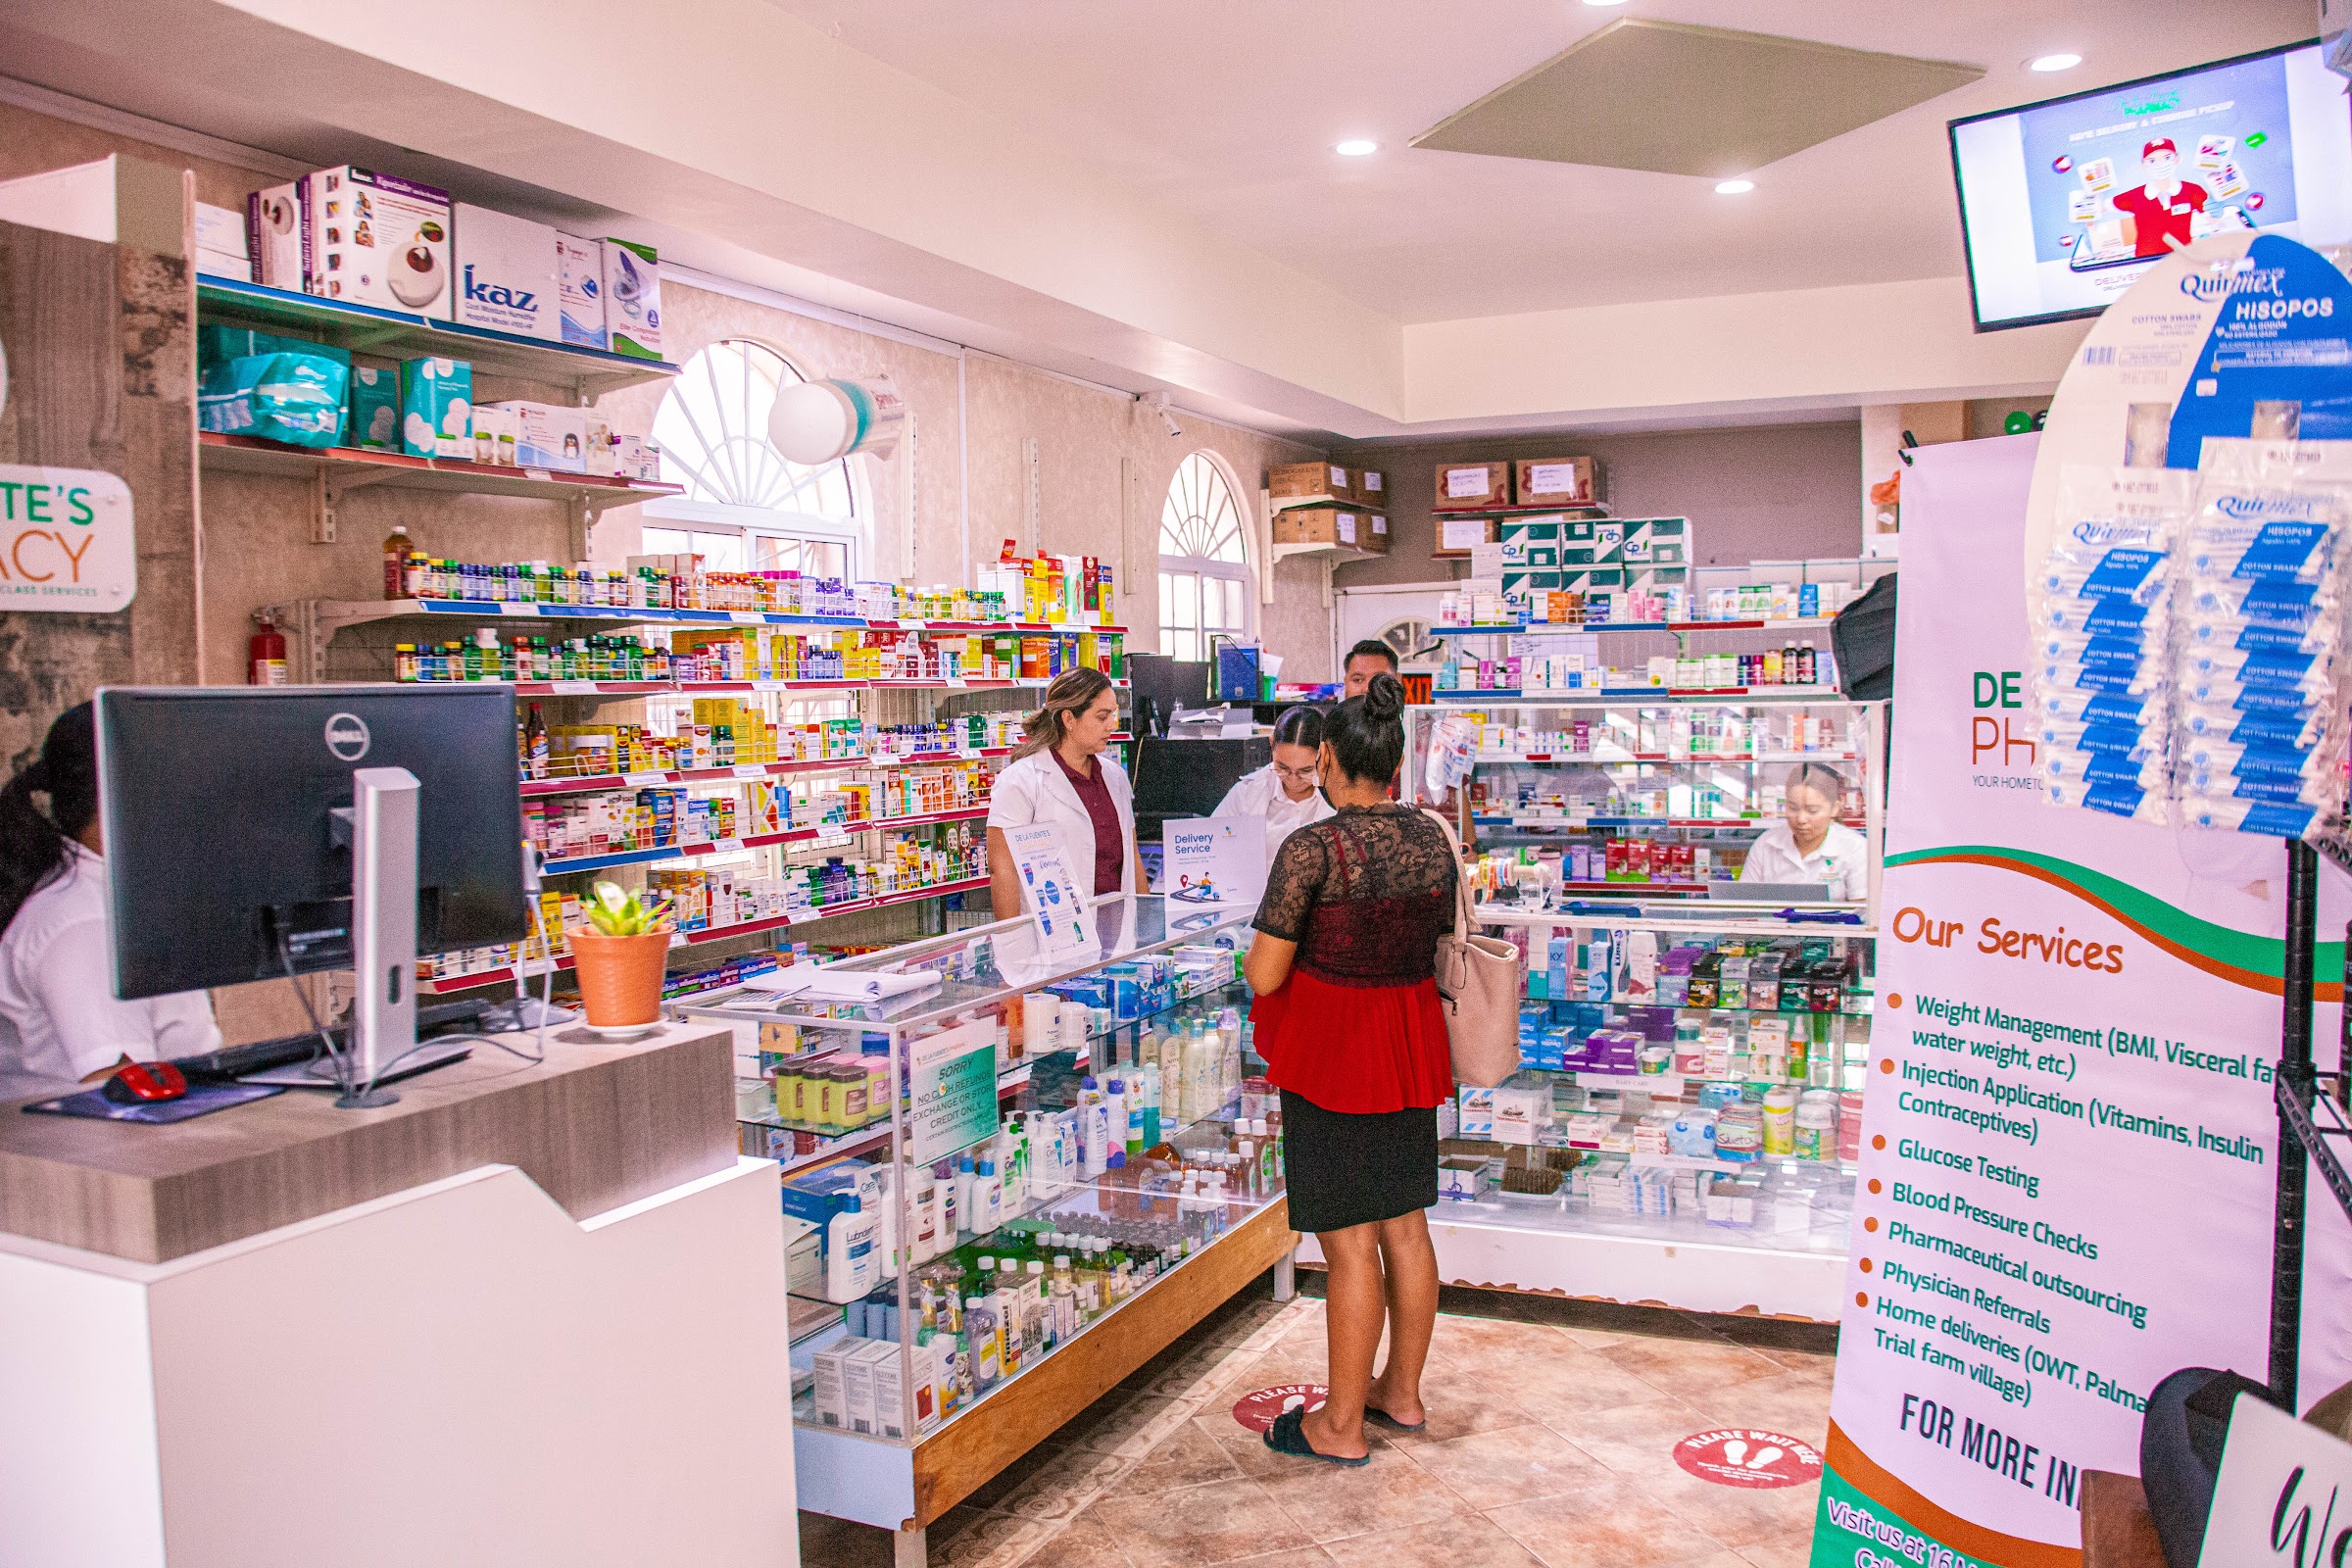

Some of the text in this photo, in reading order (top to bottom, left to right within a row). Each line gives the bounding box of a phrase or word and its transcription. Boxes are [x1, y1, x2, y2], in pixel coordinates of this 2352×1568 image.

[464, 264, 539, 313] kaz
[2235, 297, 2334, 320] HISOPOS
[1403, 676, 1433, 705] XIT
[1973, 670, 2023, 709] DE
[1972, 774, 2001, 788] YOUR
[1174, 833, 1214, 845] Delivery
[1174, 844, 1211, 855] Service
[1892, 906, 2125, 974] Our Services
[1912, 1031, 2078, 1082] water weight, etc.)
[1916, 995, 2278, 1086] Weight Management (BMI, Visceral fa
[917, 1069, 992, 1105] NO CH REFUNDS
[938, 1057, 974, 1080] SORRY
[912, 1099, 958, 1122] EXCHANGE
[958, 1094, 970, 1104] OR
[930, 1101, 983, 1129] CREDIT ONLY
[1898, 1091, 2040, 1147] Contraceptives)
[1901, 1059, 2265, 1165] Injection Application (Vitamins, Insulin
[1898, 1138, 2040, 1199] Glucose Testing
[1892, 1182, 2099, 1260] Blood Pressure Checks
[1883, 1260, 2052, 1335] Physician Referrals
[1887, 1220, 2148, 1330] Pharmaceutical outsourcing
[1876, 1296, 1936, 1331] Home
[1940, 1312, 2021, 1364] deliveries
[1874, 1327, 2033, 1408] Trial farm village)
[1250, 1386, 1306, 1402] PLEASE
[1685, 1430, 1745, 1448] PLEASE
[1748, 1430, 1797, 1447] WAIT
[1900, 1393, 1954, 1448] FOR
[1961, 1415, 2040, 1489] MORE
[1827, 1495, 1876, 1540] Visit
[1876, 1518, 1904, 1551] us
[1902, 1535, 1927, 1565] at
